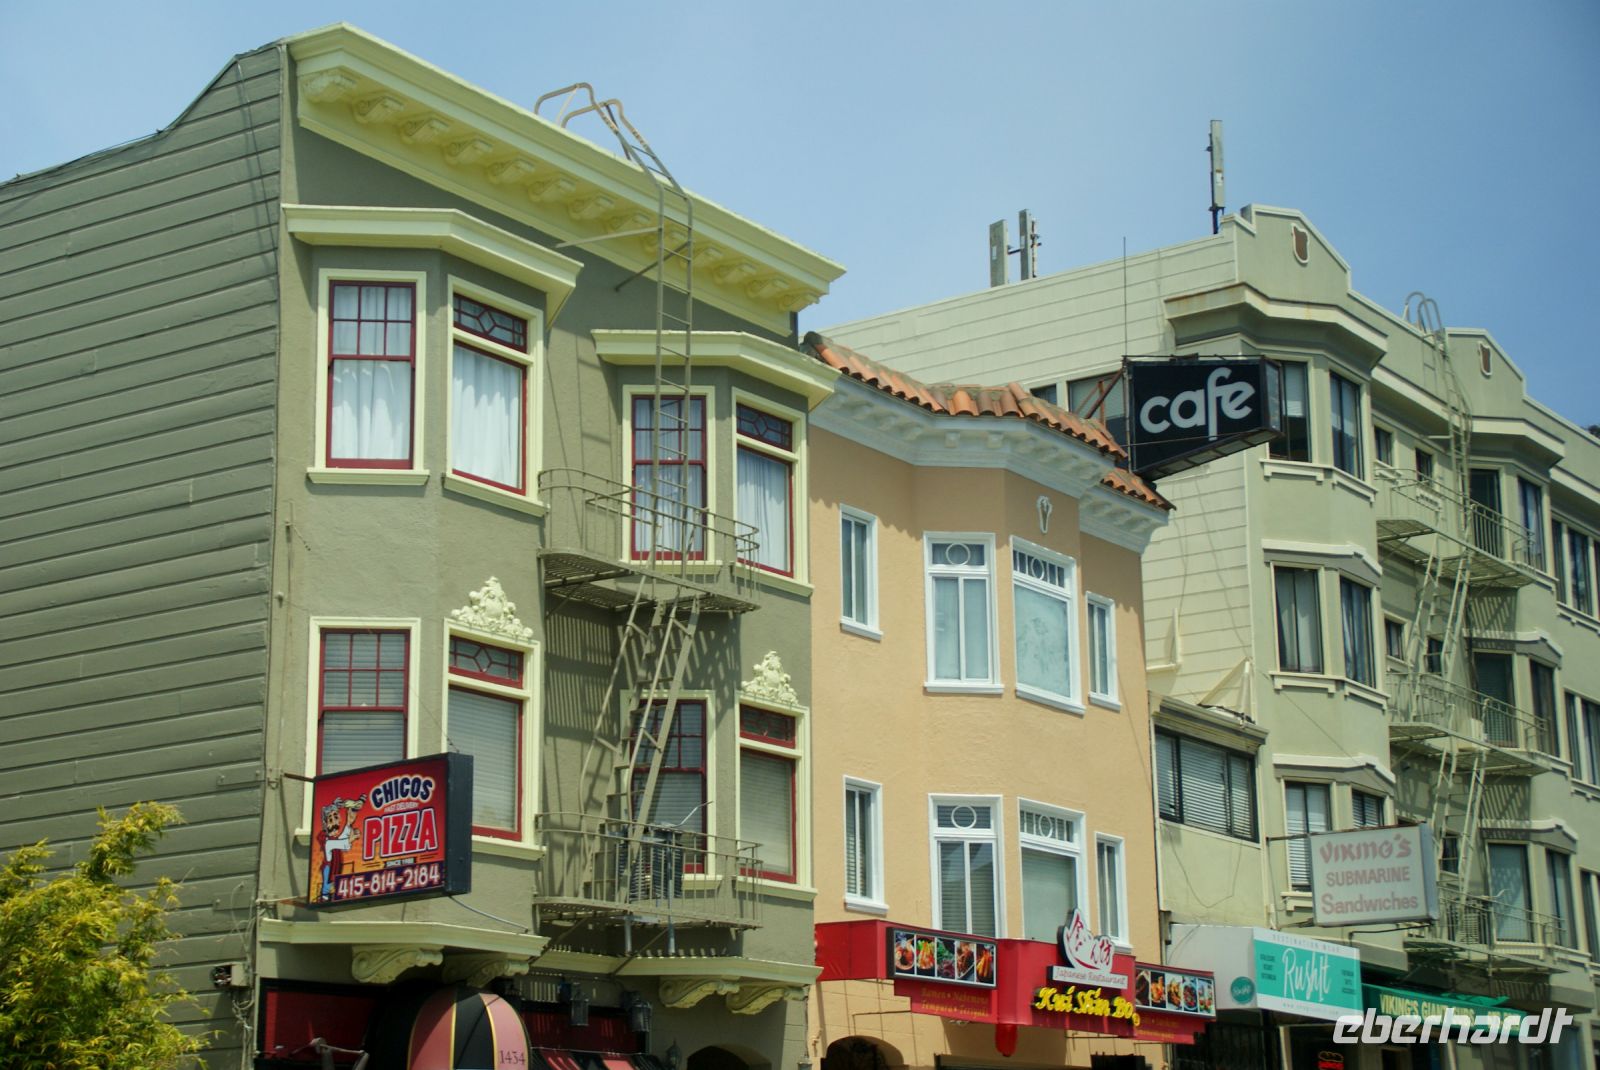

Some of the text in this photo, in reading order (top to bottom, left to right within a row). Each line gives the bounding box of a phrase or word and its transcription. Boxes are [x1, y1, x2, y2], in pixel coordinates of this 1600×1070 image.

[1140, 367, 1256, 441] cafe
[370, 775, 435, 810] CHICOS
[363, 808, 438, 860] PIZZA
[337, 863, 440, 897] 415-814-2184
[1326, 866, 1411, 887] SUBMARINE
[1321, 891, 1419, 915] Sandwiches
[1379, 994, 1419, 1018] VIKING'S
